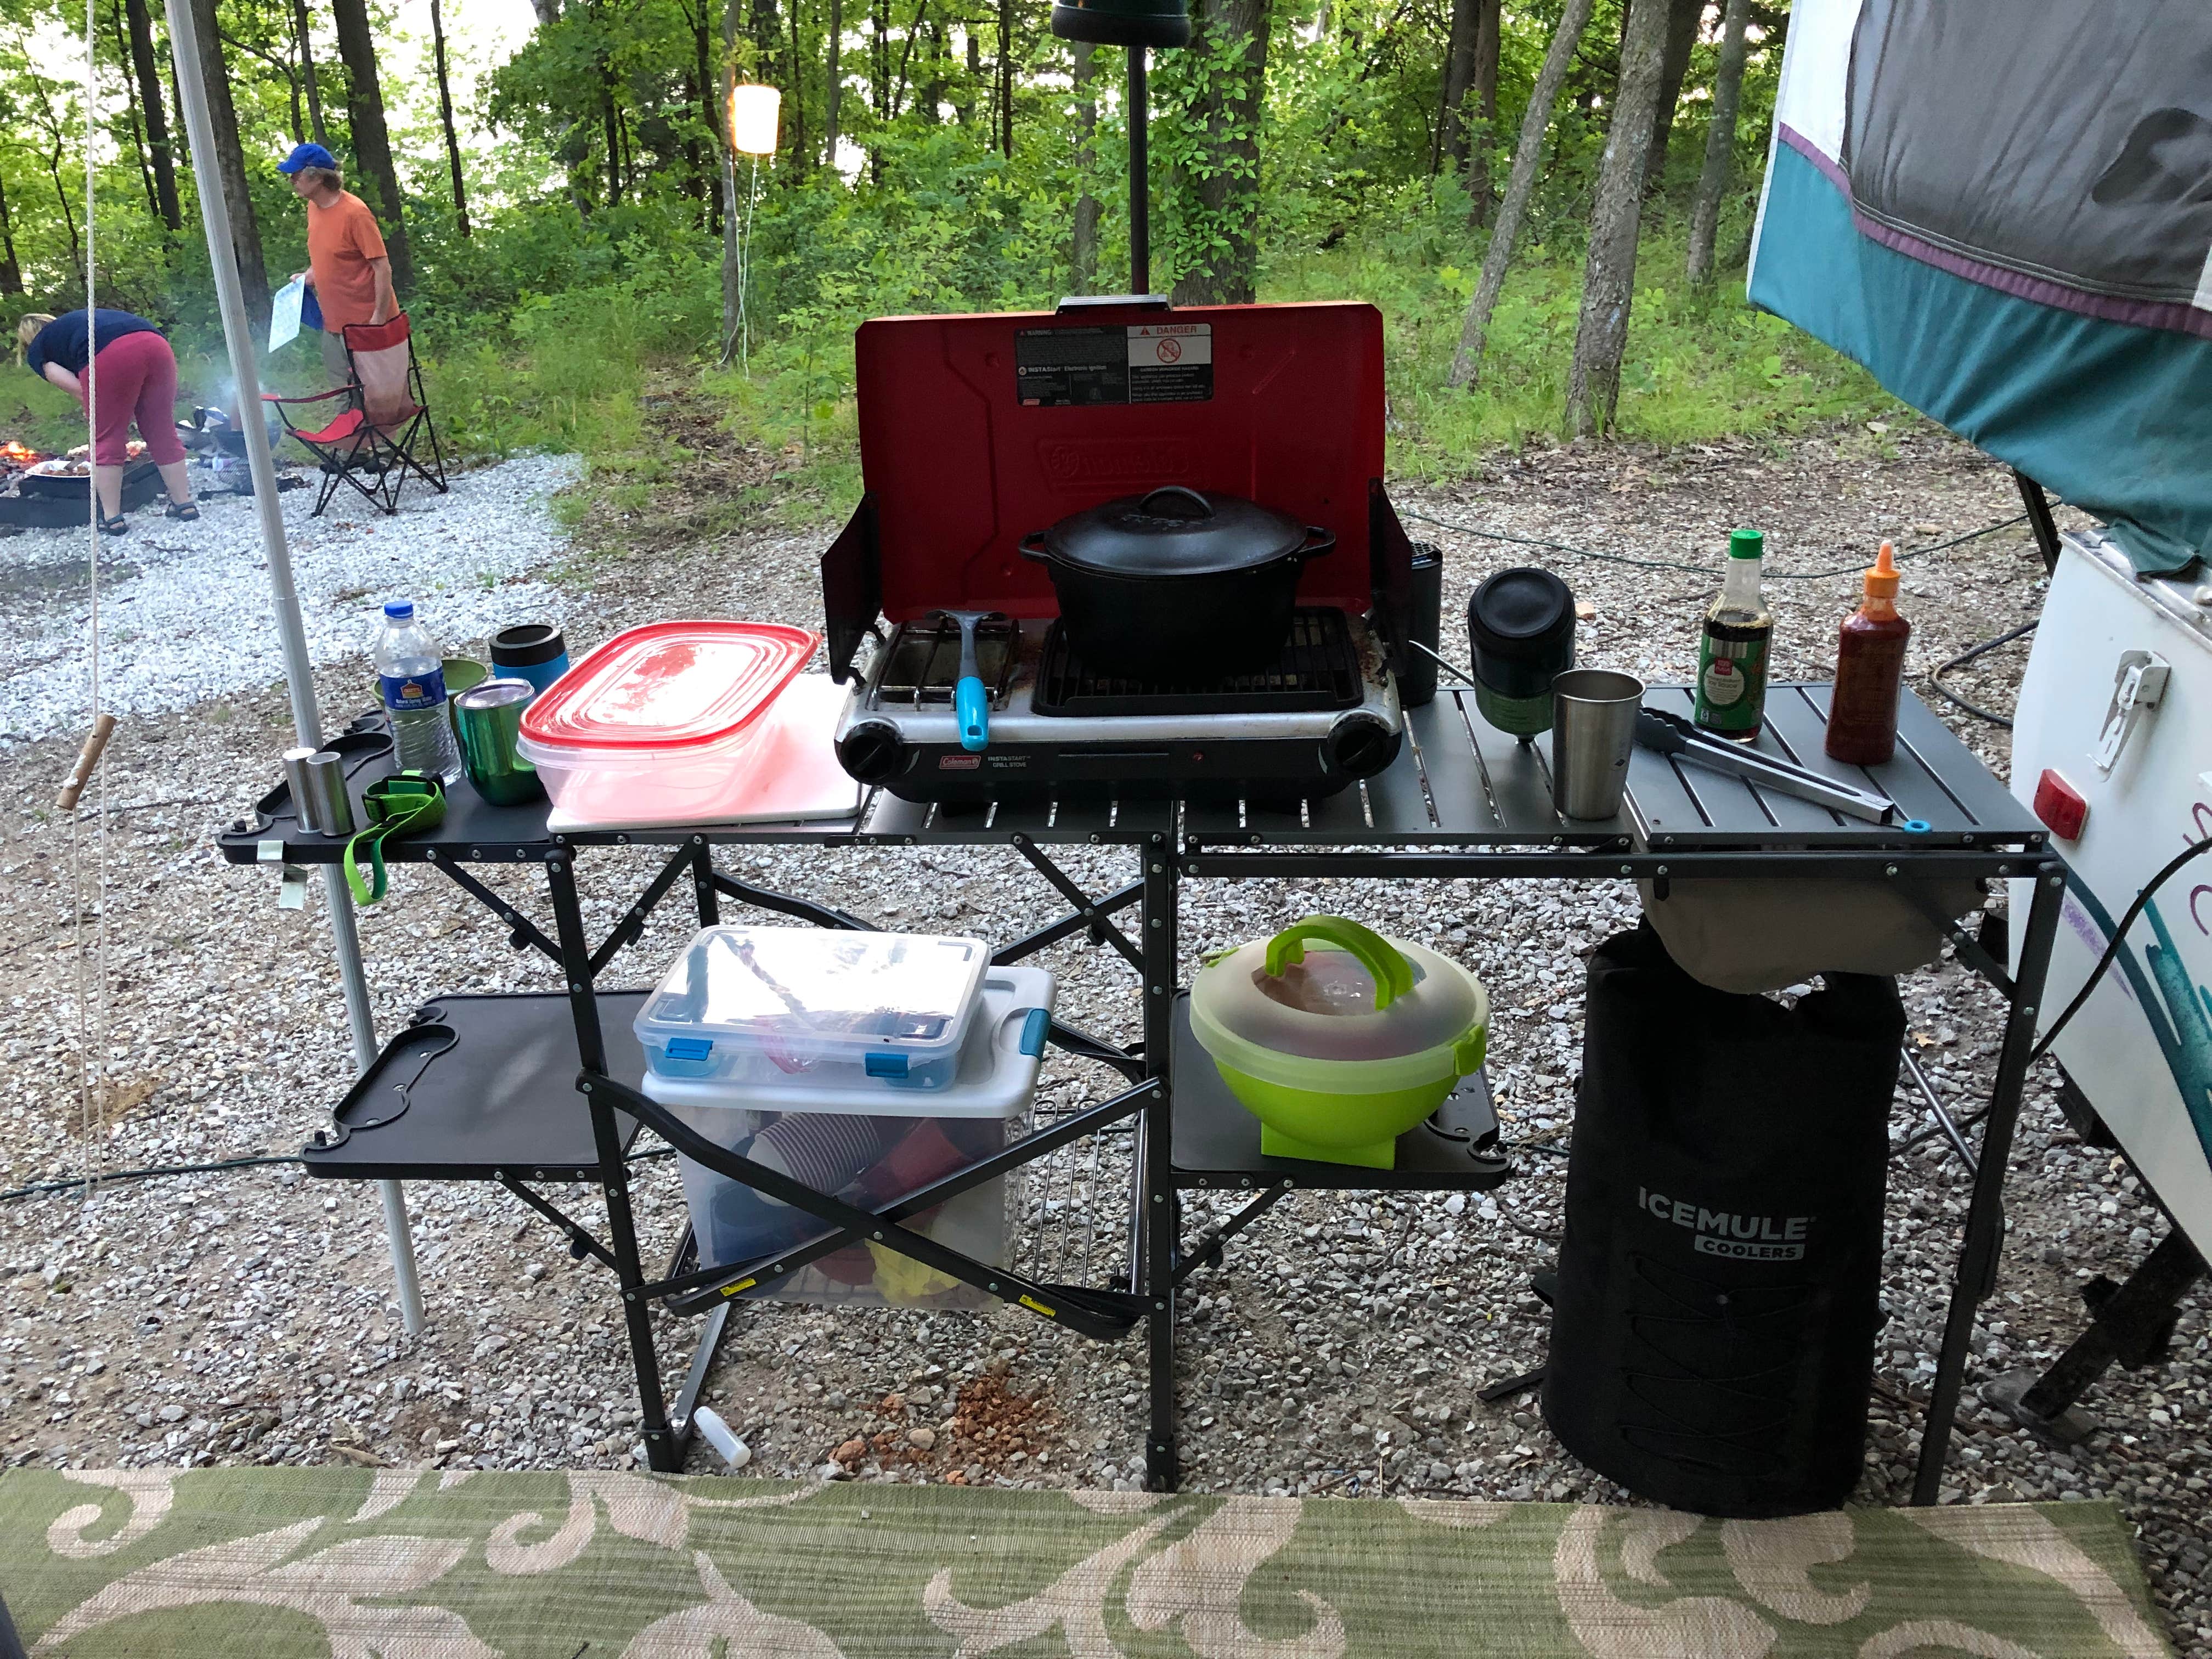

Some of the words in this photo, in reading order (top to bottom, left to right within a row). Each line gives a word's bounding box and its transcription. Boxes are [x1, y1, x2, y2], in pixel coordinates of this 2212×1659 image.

[1156, 325, 1197, 335] DANGER
[942, 758, 972, 766] Coleman
[1639, 1186, 1808, 1240] ICEMULE
[1703, 1240, 1796, 1259] COOLERS
